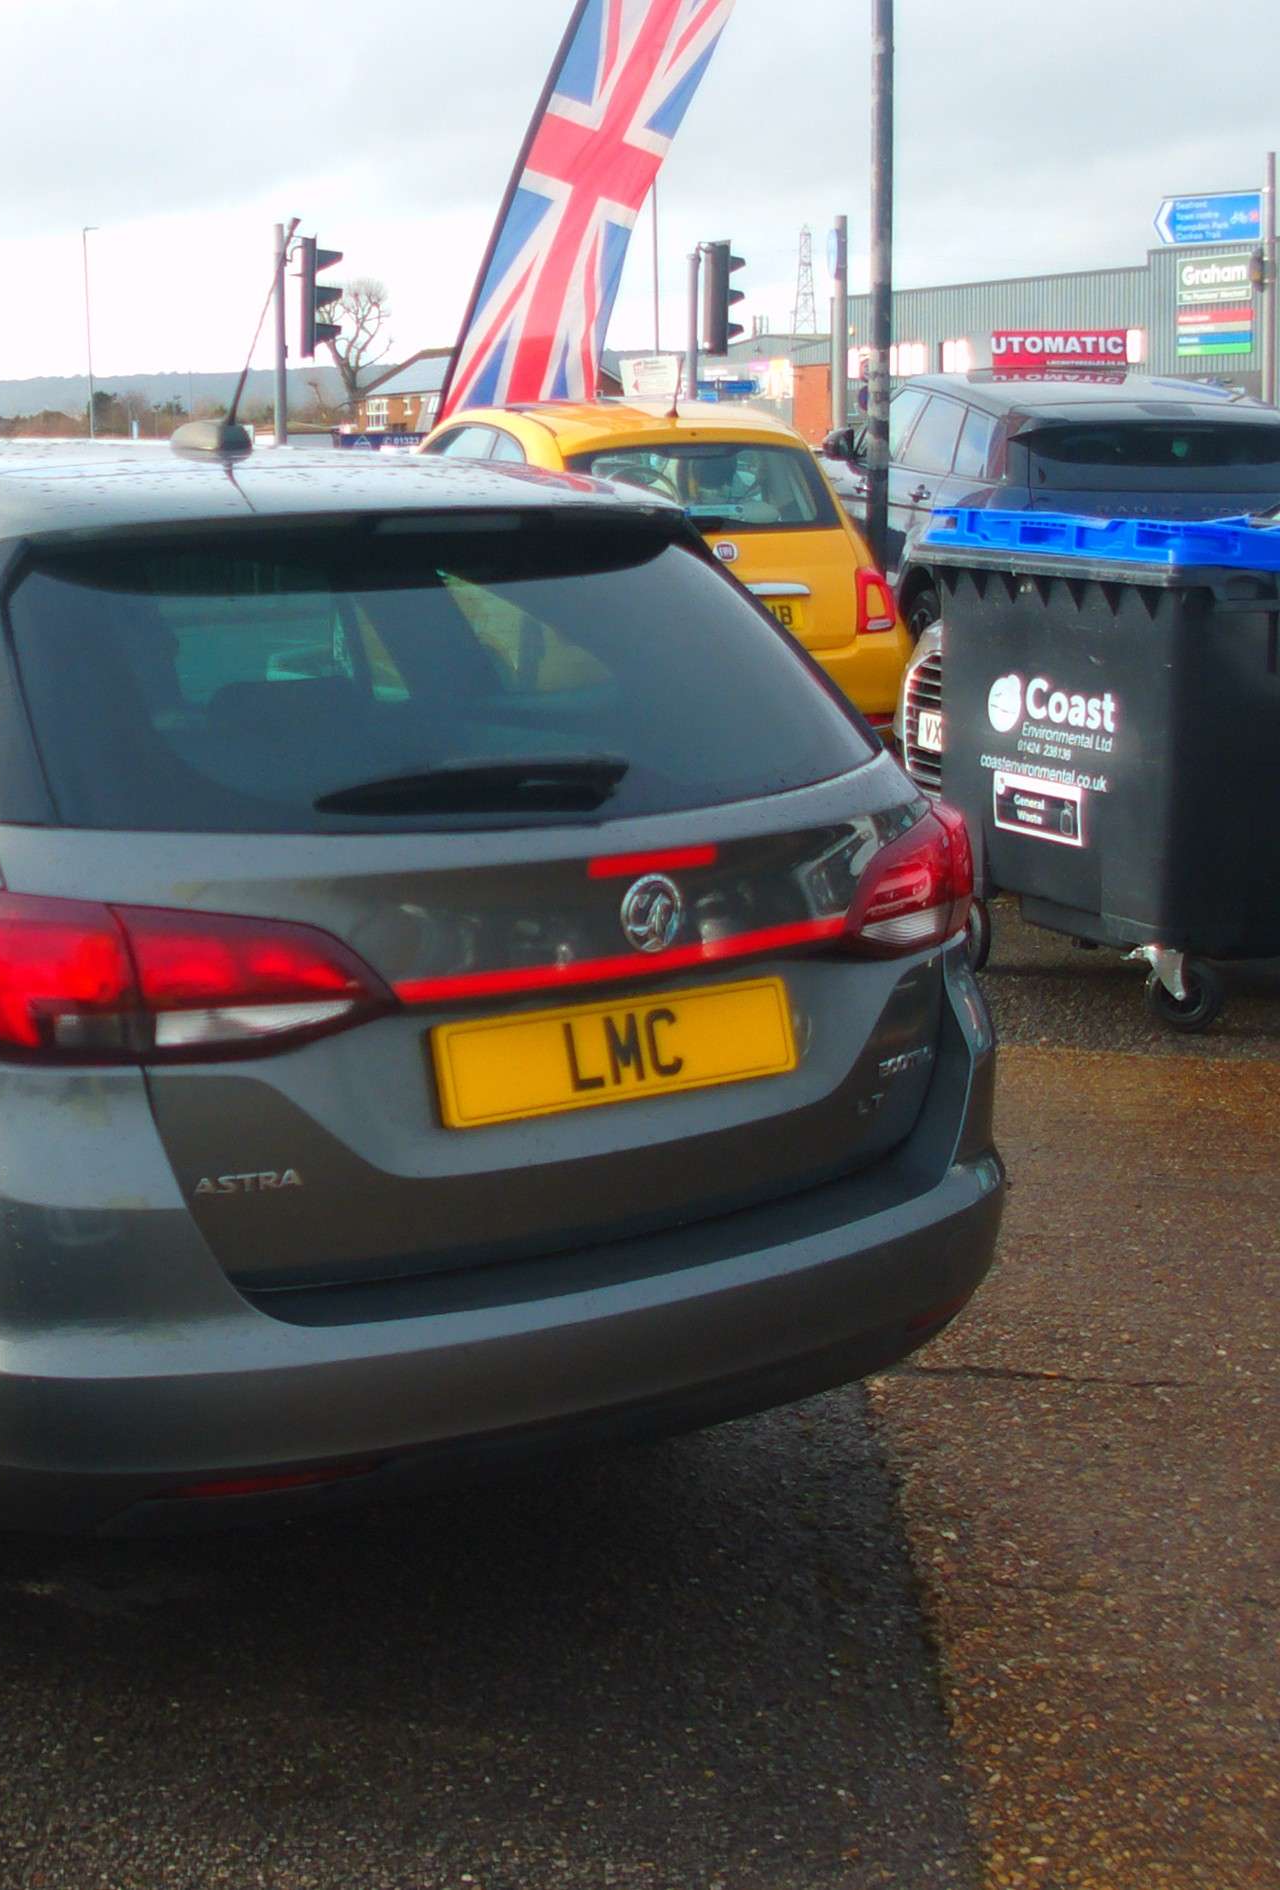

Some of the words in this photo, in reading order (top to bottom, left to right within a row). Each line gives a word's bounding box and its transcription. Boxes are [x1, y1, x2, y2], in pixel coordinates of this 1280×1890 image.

[1181, 263, 1247, 287] Graham
[1025, 677, 1116, 733] Coast
[1022, 721, 1094, 749] Environmental
[1094, 735, 1113, 752] Ltd
[980, 753, 1108, 792] coastenvironmental.co.uk
[1013, 794, 1045, 810] General
[1016, 808, 1043, 825] Waste
[561, 1007, 683, 1093] LMC
[193, 1168, 302, 1195] ASTRA
